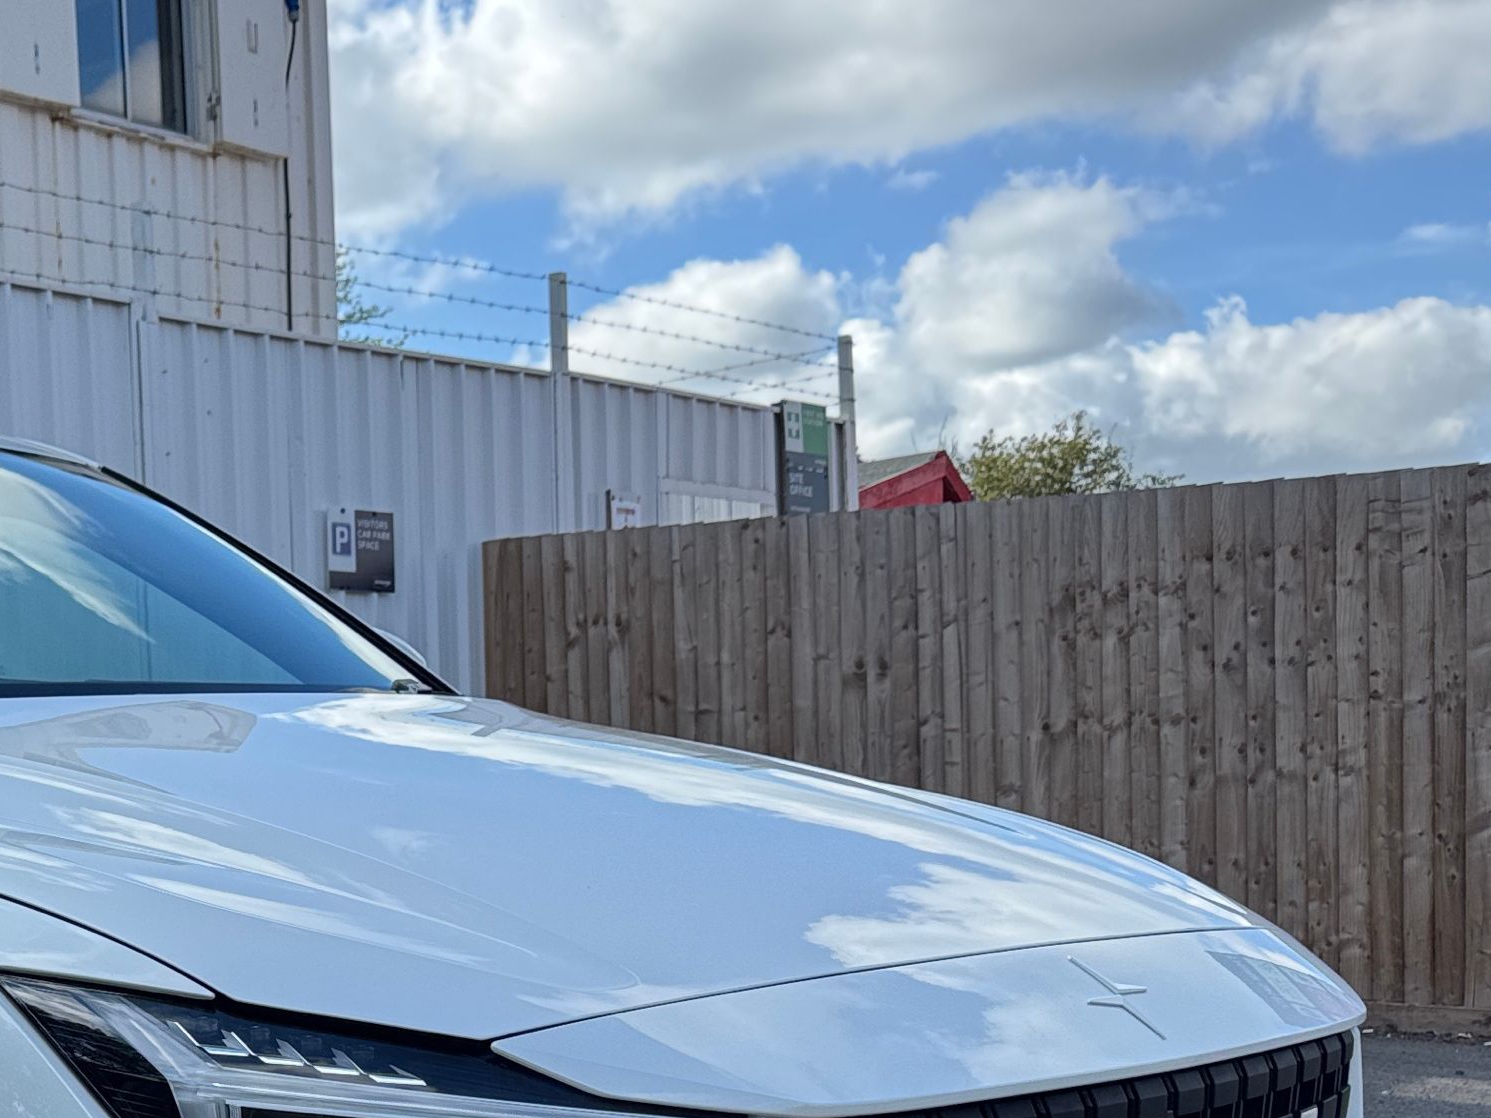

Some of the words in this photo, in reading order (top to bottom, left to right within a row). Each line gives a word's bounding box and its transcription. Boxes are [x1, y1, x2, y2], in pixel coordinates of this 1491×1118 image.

[789, 472, 804, 484] SITE
[789, 484, 813, 498] OFFICE
[335, 526, 349, 553] P
[356, 530, 371, 540] CAR
[372, 530, 391, 541] PARK
[356, 540, 380, 552] SPACE
